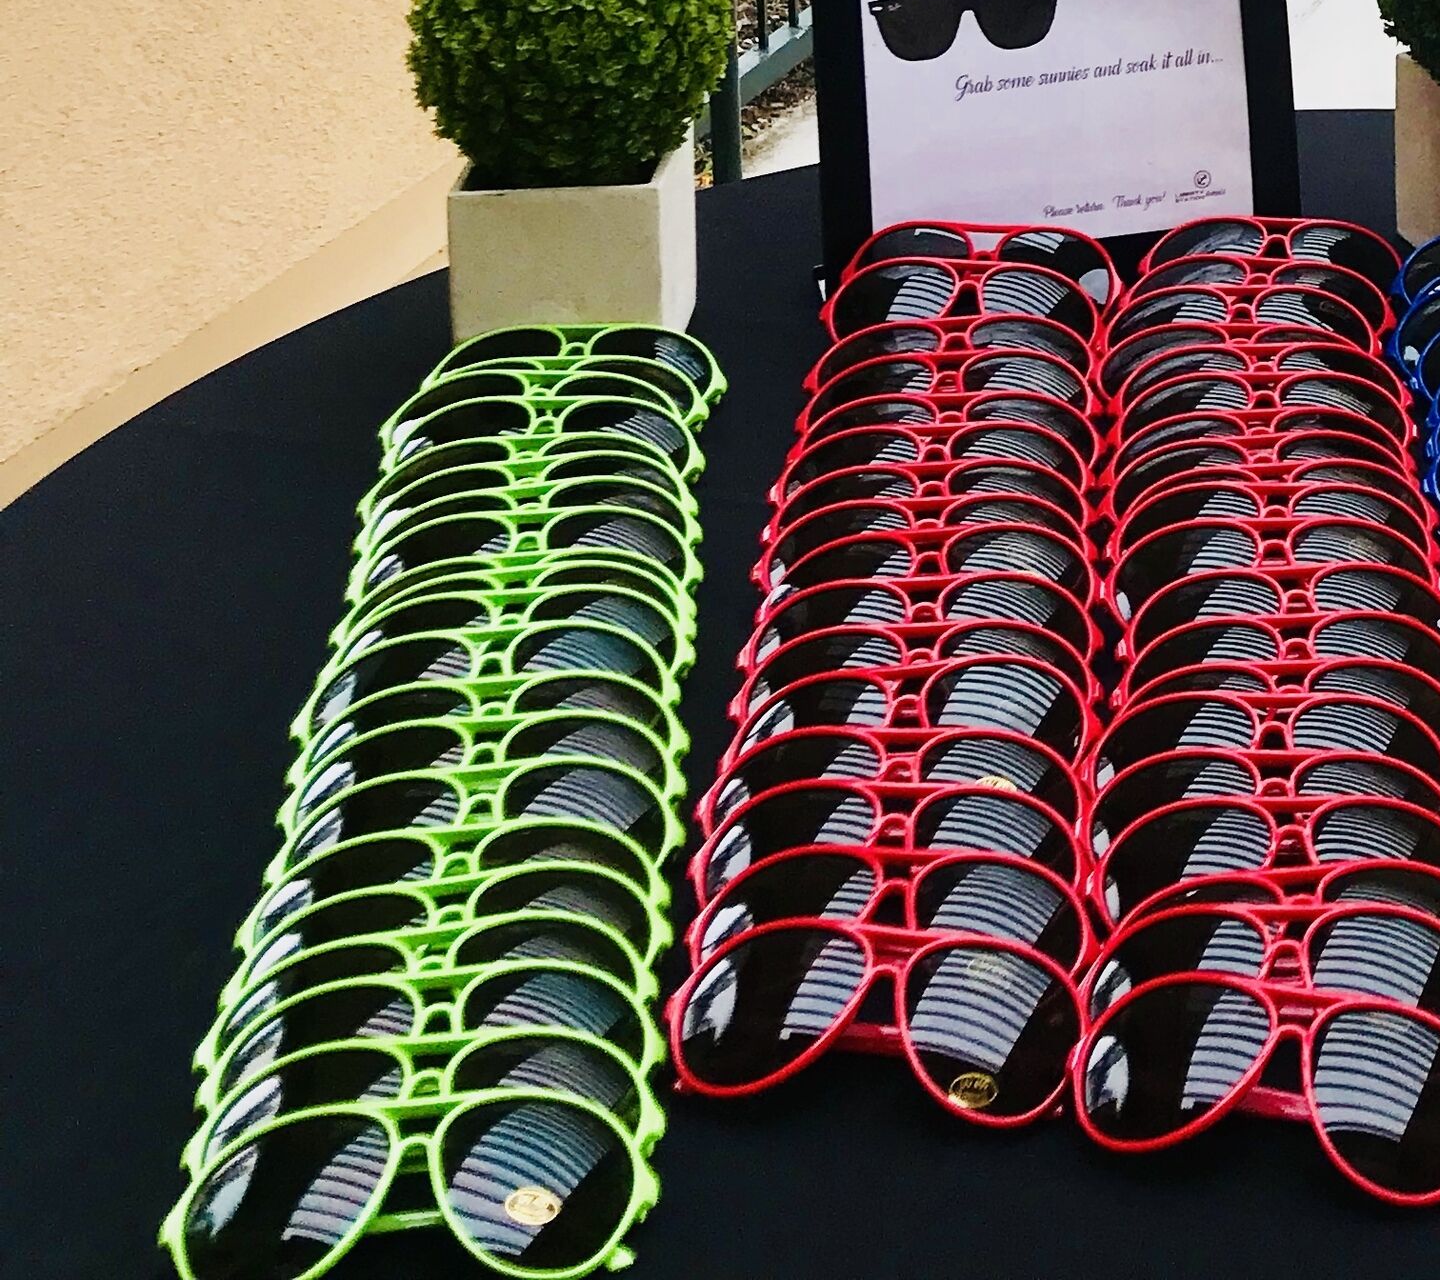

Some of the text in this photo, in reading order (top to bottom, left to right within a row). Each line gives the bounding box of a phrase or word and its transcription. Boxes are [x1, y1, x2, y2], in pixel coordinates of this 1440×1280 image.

[955, 73, 993, 102] Grab
[996, 74, 1034, 91] some
[1038, 65, 1090, 86] sunnies
[1093, 58, 1122, 78] and
[1126, 53, 1157, 73] soak
[1161, 50, 1173, 70] it
[1175, 48, 1193, 67] all
[1112, 194, 1142, 209] Thank
